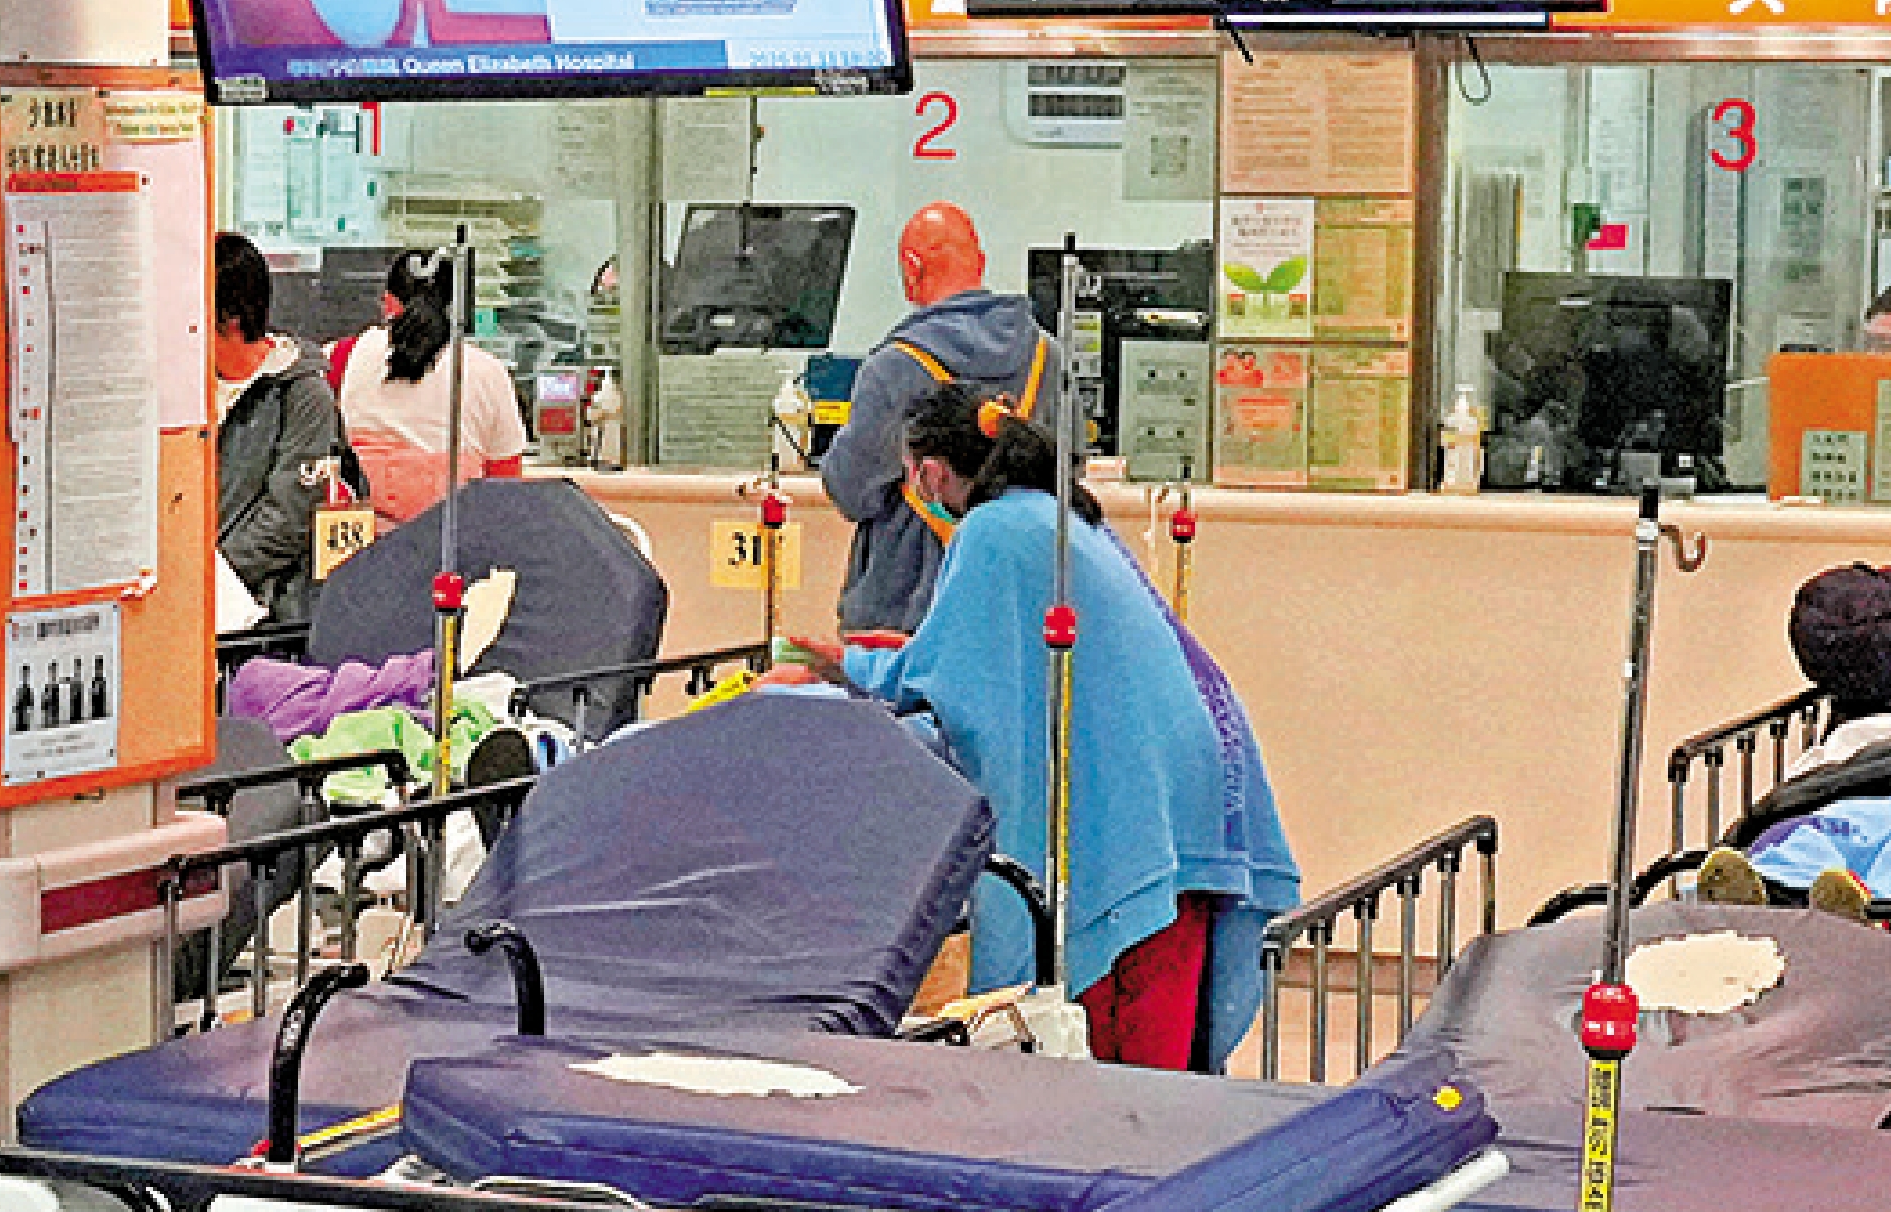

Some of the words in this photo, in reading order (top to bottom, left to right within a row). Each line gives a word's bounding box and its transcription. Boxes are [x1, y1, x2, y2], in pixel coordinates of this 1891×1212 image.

[401, 58, 465, 74] Queen
[469, 54, 552, 74] Elizabeth
[554, 50, 635, 74] Hospital
[912, 91, 958, 159] 2
[1710, 98, 1758, 171] 3
